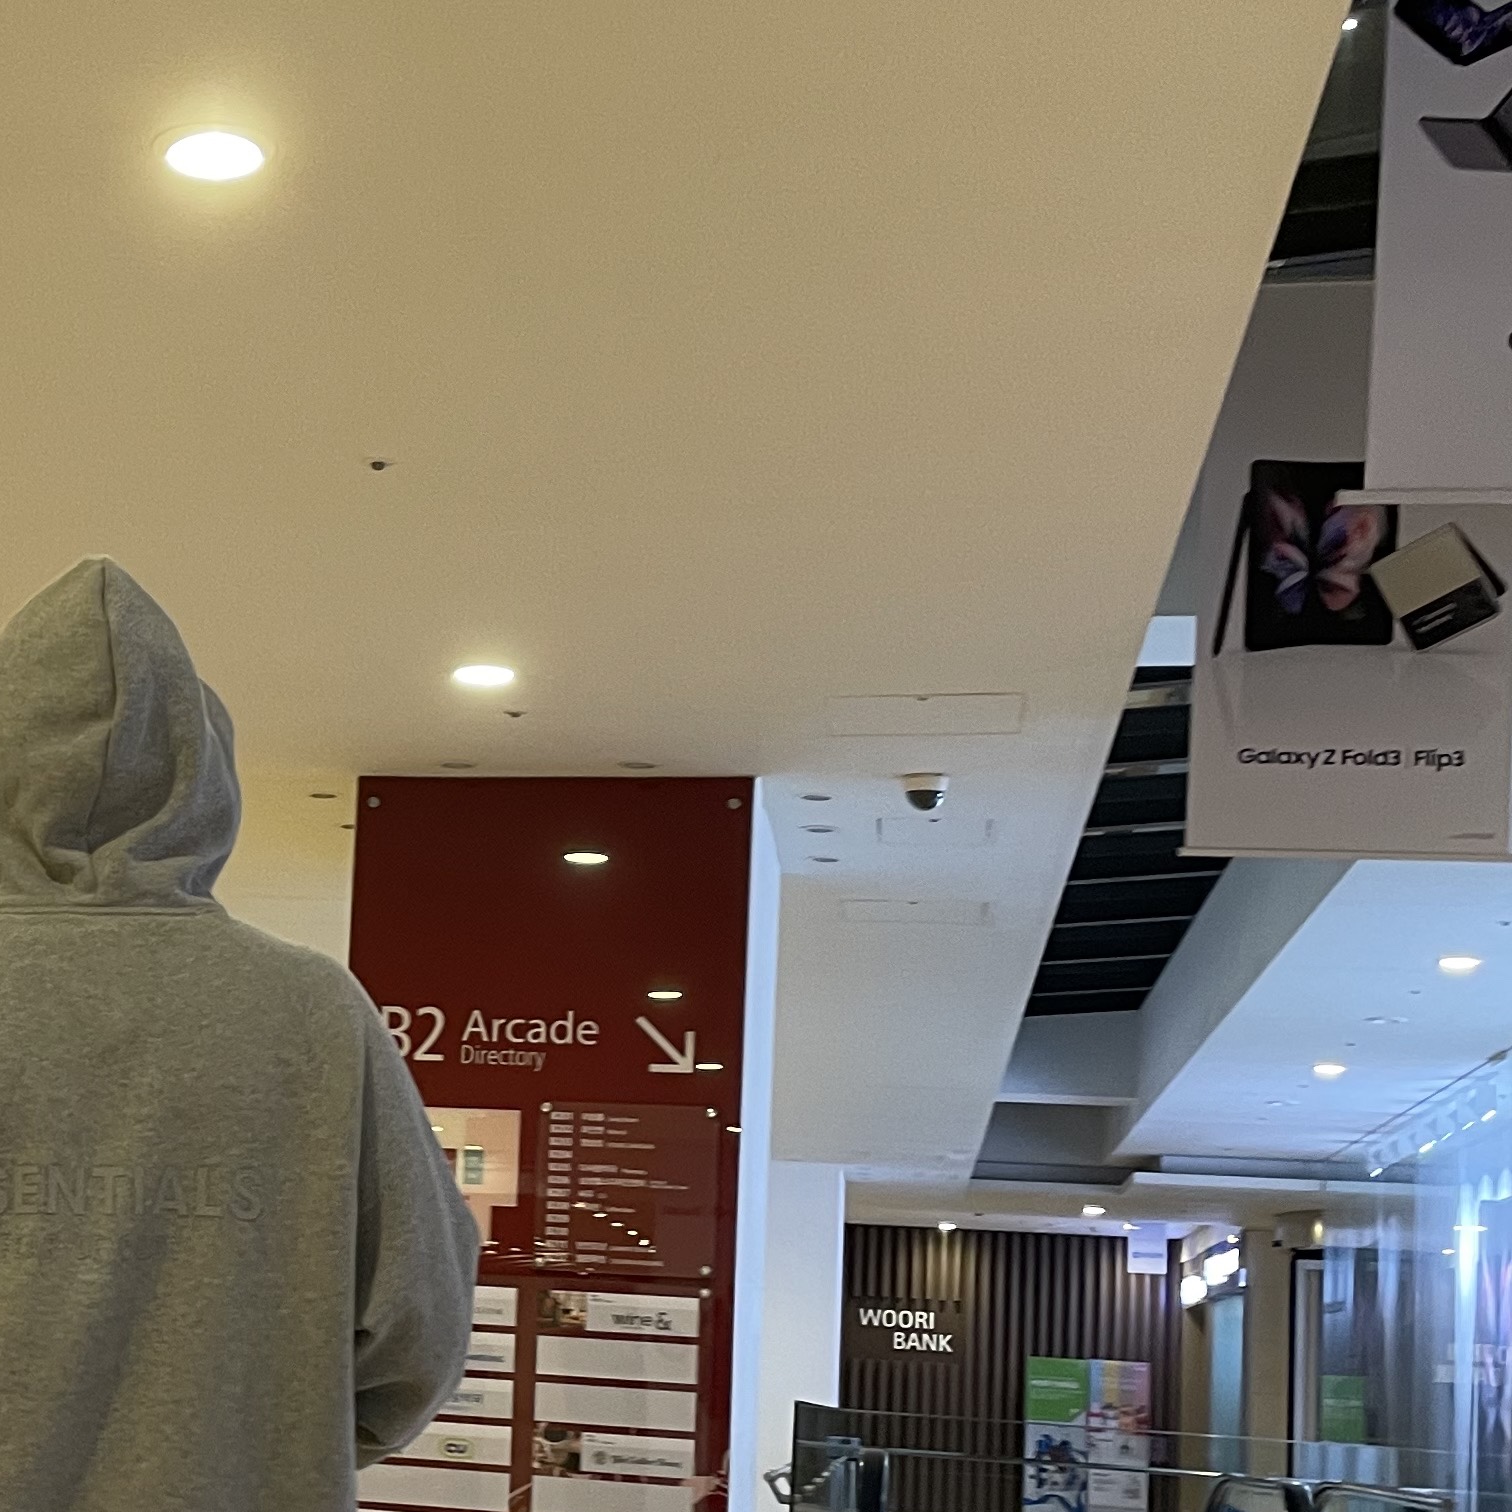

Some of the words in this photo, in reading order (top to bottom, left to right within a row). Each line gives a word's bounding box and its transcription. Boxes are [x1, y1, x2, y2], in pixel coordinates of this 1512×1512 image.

[1239, 748, 1320, 769] Galaxy
[1323, 749, 1336, 765] Z
[1341, 749, 1401, 766] Fold3
[1414, 748, 1465, 772] Flip3
[381, 1005, 446, 1062] B2
[461, 1009, 600, 1045] Arcade
[460, 1044, 547, 1072] Directory
[859, 1307, 935, 1330] WOORI
[893, 1331, 954, 1353] BANK
